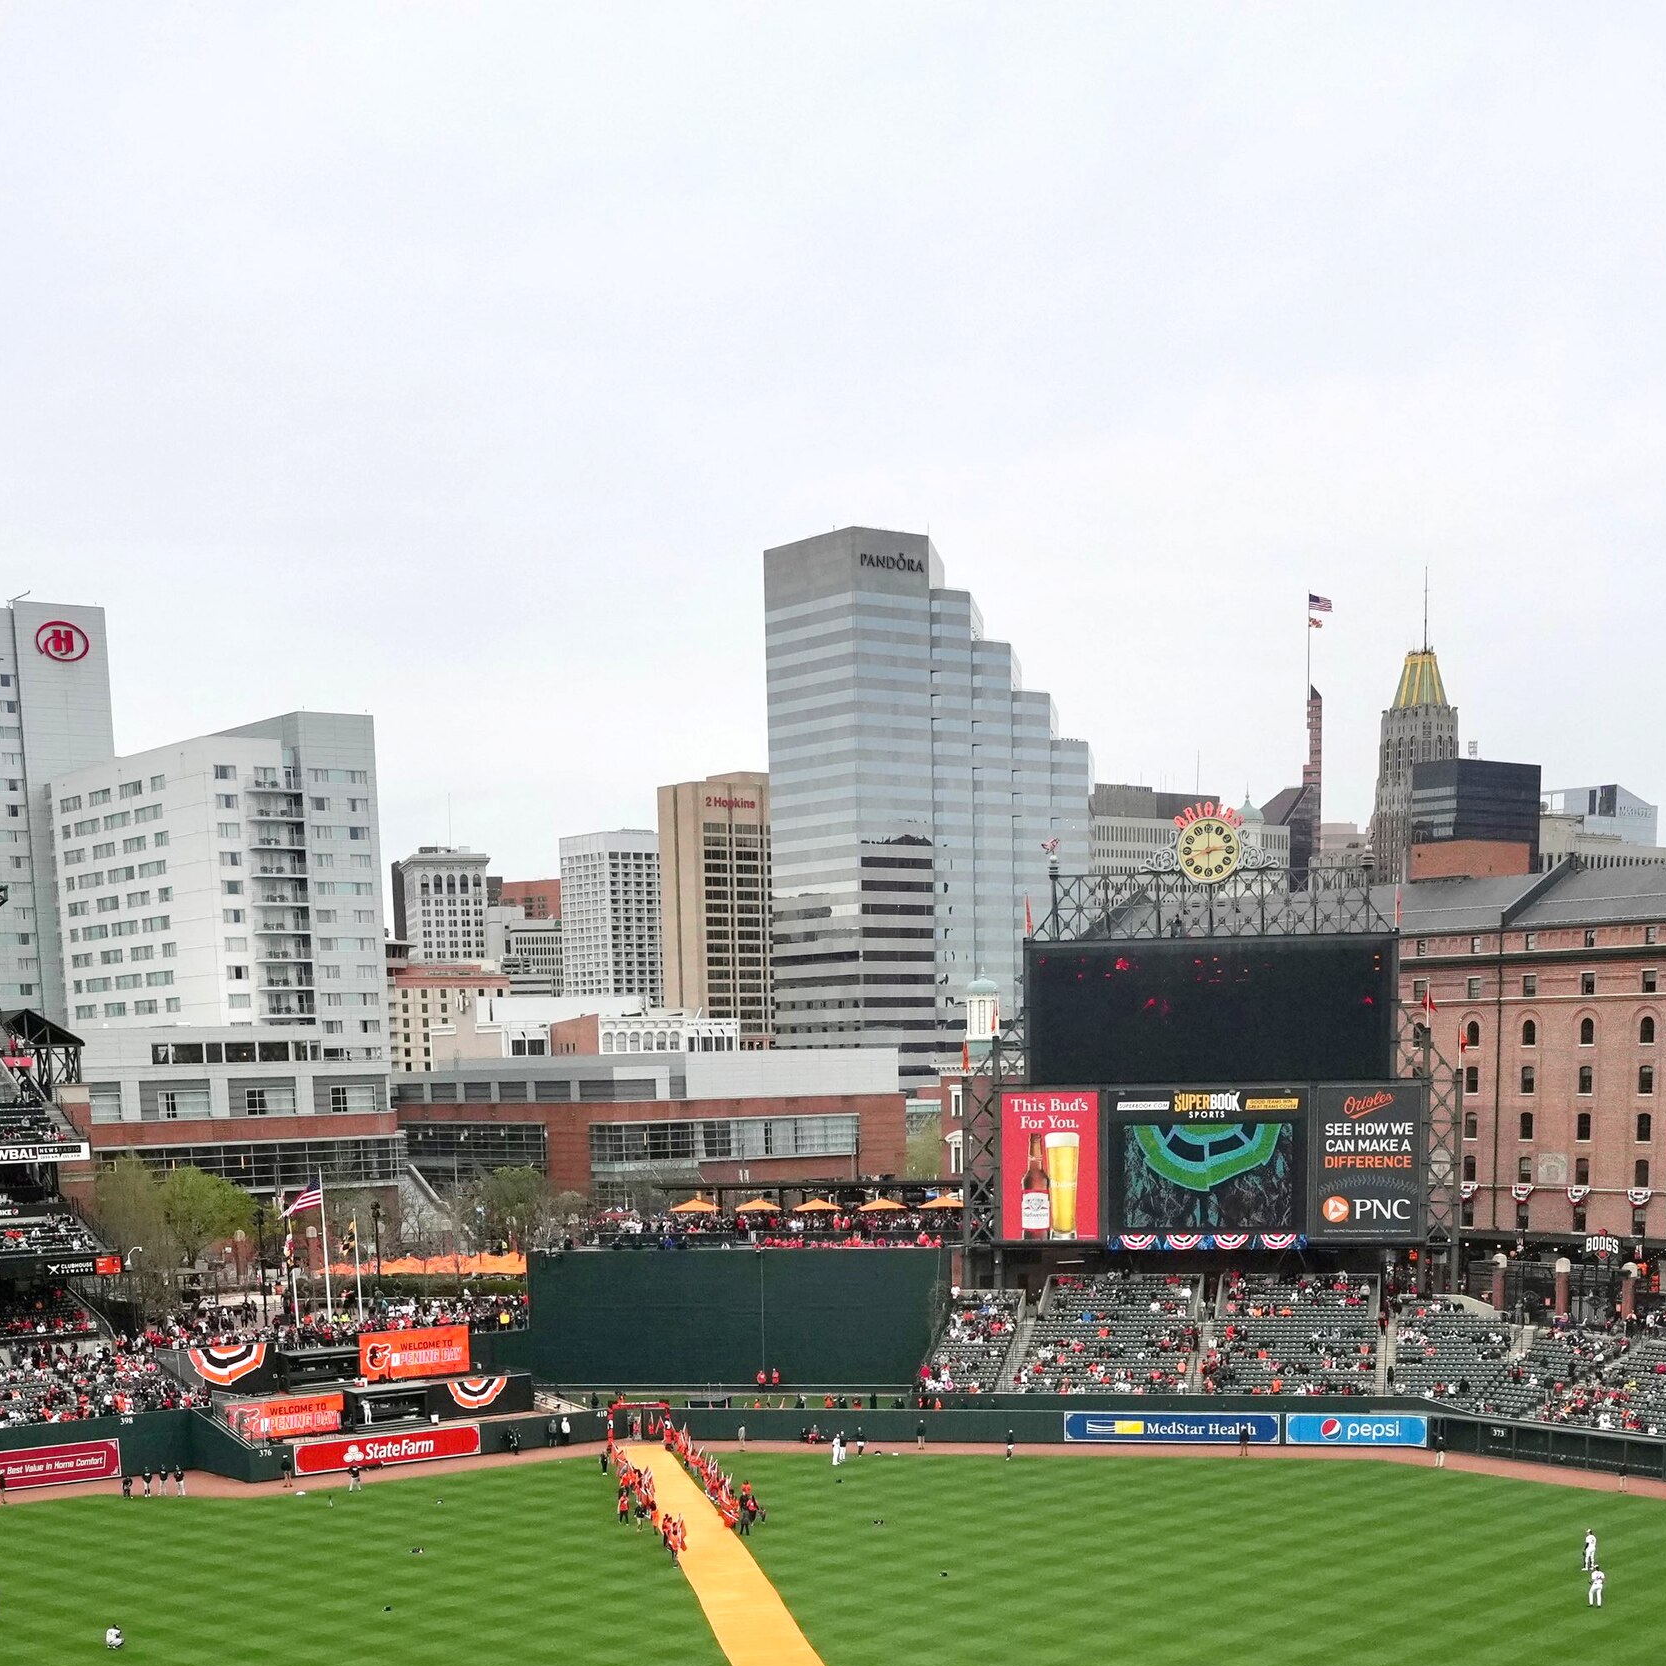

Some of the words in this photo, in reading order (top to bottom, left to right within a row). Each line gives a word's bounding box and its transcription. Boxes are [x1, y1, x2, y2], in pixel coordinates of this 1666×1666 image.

[705, 796, 712, 807] 2
[714, 796, 755, 809] Hopkins
[1174, 801, 1245, 829] ORIOLES
[1011, 1099, 1045, 1112] This
[1050, 1098, 1089, 1112] Bud's
[1174, 1092, 1241, 1112] SUPERBOOK
[1344, 1091, 1395, 1116] Orioles
[1021, 1116, 1044, 1129] For
[1048, 1115, 1079, 1129] You.
[1325, 1123, 1352, 1136] SEE
[1355, 1122, 1389, 1135] HOW
[1391, 1122, 1414, 1135] WE
[1326, 1139, 1354, 1152] CAN
[1358, 1139, 1398, 1152] MAKE
[1401, 1139, 1412, 1151] A
[1324, 1155, 1412, 1168] DIFFERENCE
[1353, 1199, 1411, 1220] PNC
[1586, 1236, 1619, 1254] BOOG'S
[60, 1261, 93, 1269] CLUBHOUSE
[400, 1340, 435, 1350] WELCOME
[438, 1338, 453, 1348] TO
[391, 1350, 439, 1366] OPENING
[441, 1346, 462, 1361] DAY
[269, 1404, 307, 1415] WELCOME
[312, 1402, 327, 1411] TO
[596, 1410, 608, 1418] 410
[120, 1417, 133, 1425] 398
[260, 1413, 311, 1431] OPENING
[313, 1410, 337, 1428] DAY
[1146, 1422, 1204, 1436] MedStar
[1347, 1421, 1399, 1440] pepsi
[1492, 1428, 1505, 1437] 373
[259, 1449, 272, 1457] 376
[7, 1465, 23, 1475] Best
[24, 1463, 44, 1473] Value
[46, 1462, 52, 1470] in
[54, 1460, 74, 1469] Home
[76, 1456, 104, 1466] Comfort
